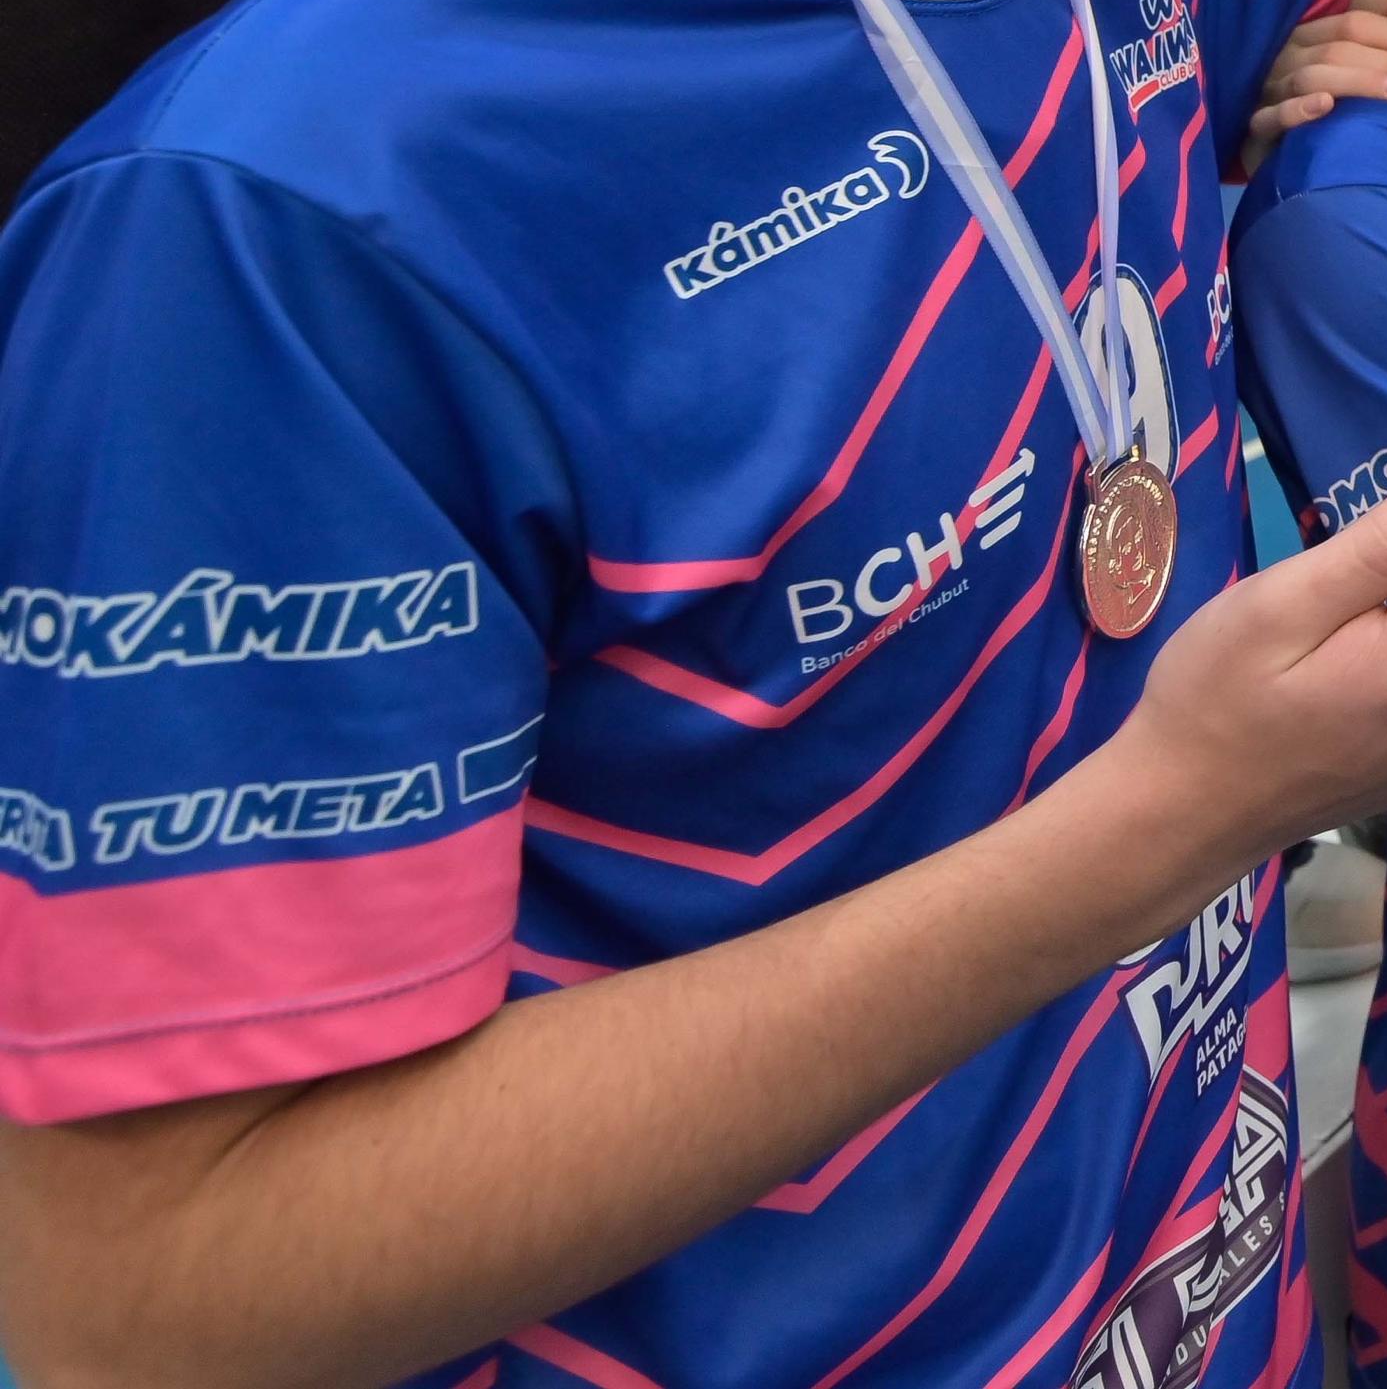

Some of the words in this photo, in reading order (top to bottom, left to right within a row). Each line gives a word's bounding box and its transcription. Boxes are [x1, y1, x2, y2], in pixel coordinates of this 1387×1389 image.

[664, 167, 889, 300] kámika
[786, 510, 964, 645] BCH
[801, 630, 869, 675] Banco
[872, 618, 903, 644] del
[908, 578, 971, 625] Chubut
[90, 788, 226, 864] TU
[219, 762, 443, 845] META
[1196, 1007, 1237, 1072] ALMA
